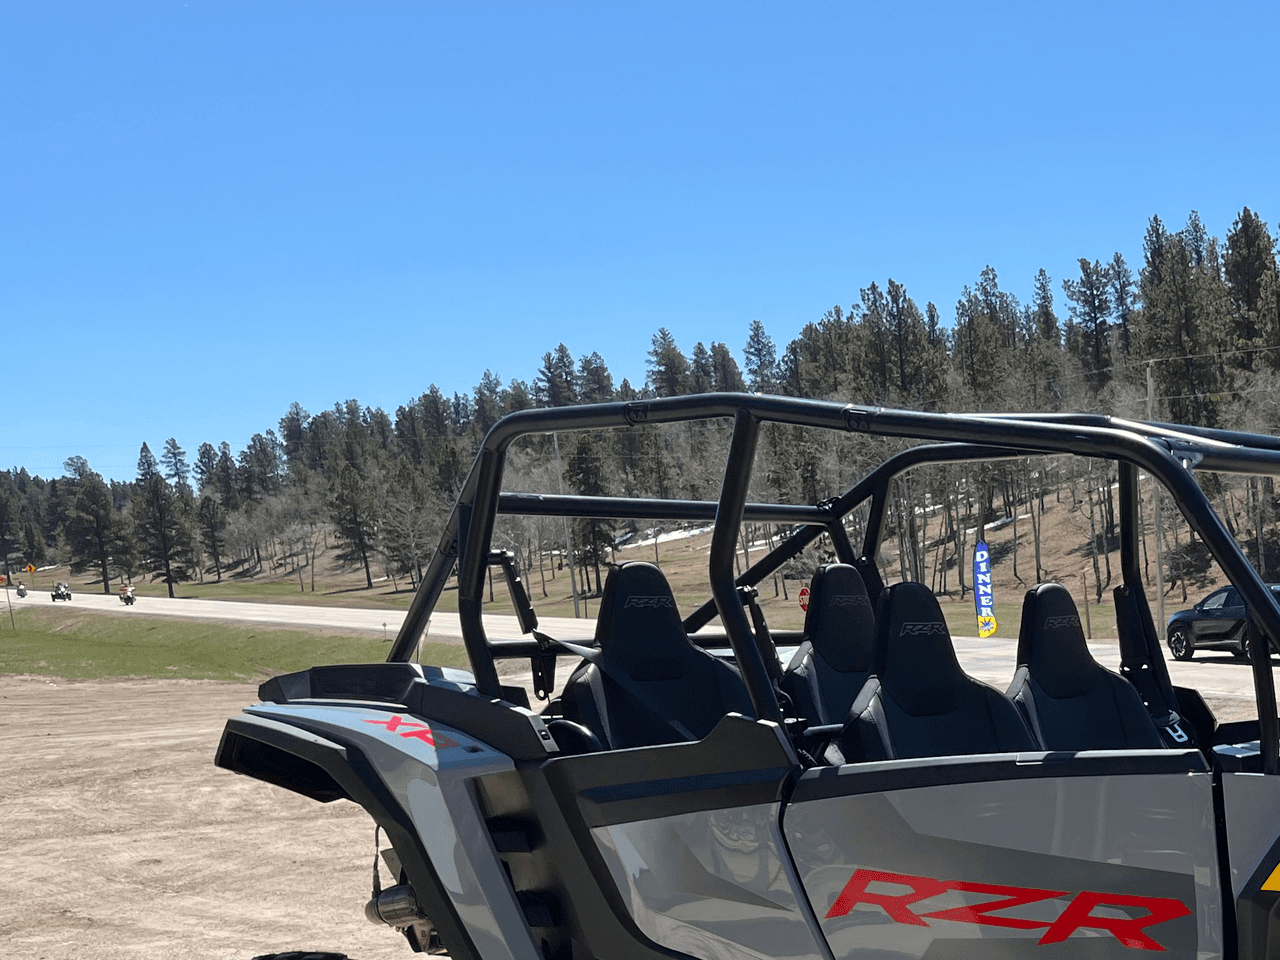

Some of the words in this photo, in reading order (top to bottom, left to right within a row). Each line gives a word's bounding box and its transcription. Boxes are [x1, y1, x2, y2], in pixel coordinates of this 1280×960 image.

[624, 595, 673, 609] RZR
[975, 550, 994, 617] DINNER
[899, 621, 946, 637] RZR
[825, 868, 1191, 952] RZR
